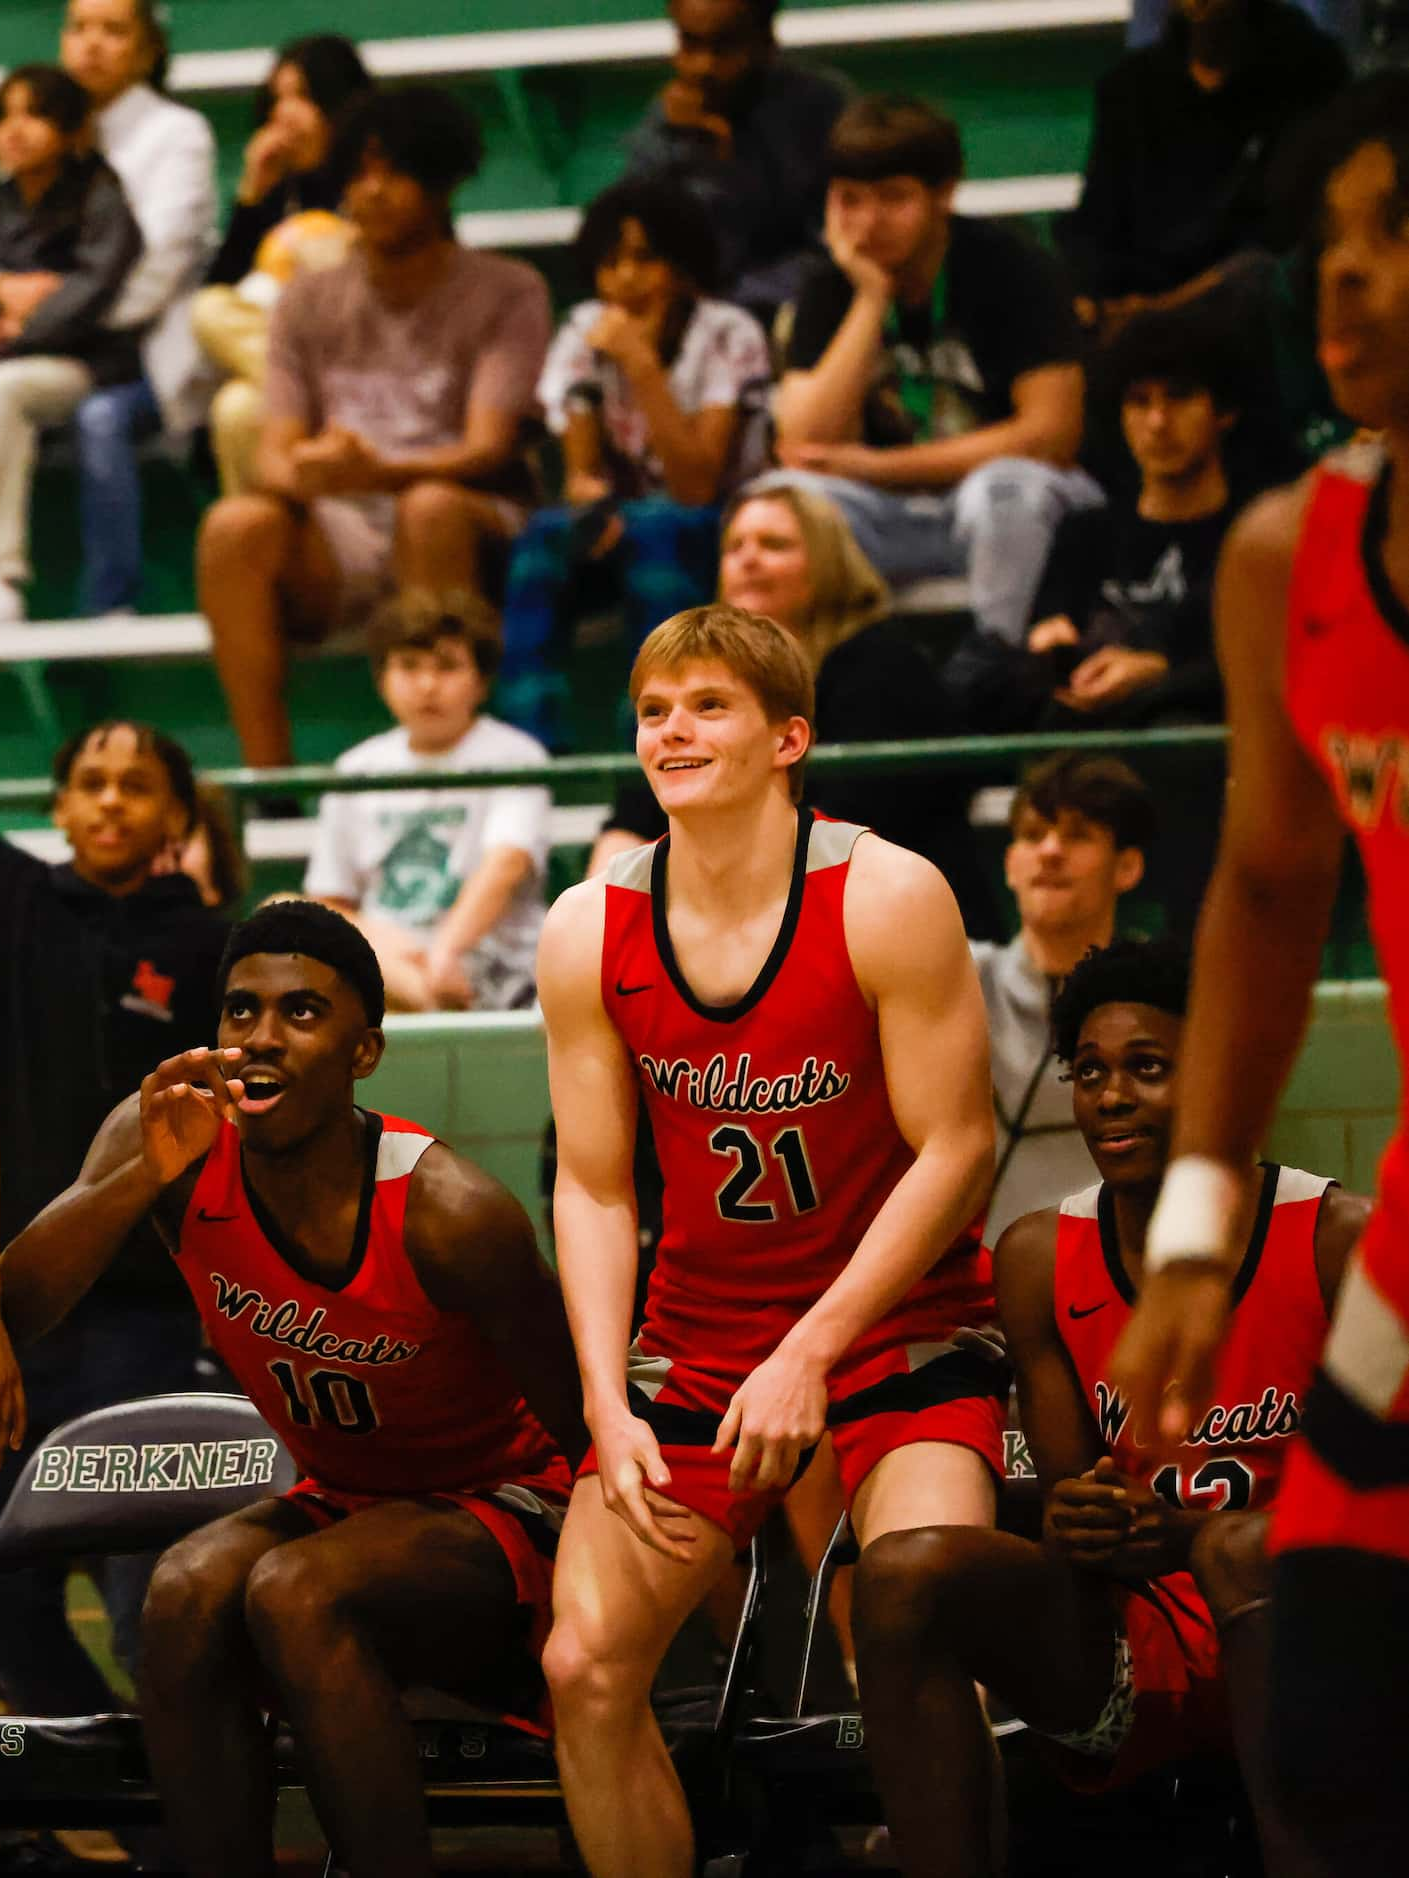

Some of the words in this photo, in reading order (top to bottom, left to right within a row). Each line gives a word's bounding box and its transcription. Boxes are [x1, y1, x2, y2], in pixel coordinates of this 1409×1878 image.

[640, 1052, 850, 1114] Wildcats
[708, 1123, 820, 1224] 21
[210, 1272, 420, 1366] Wildcats
[267, 1359, 383, 1435] 10
[1094, 1380, 1305, 1447] Wcats
[30, 1437, 279, 1493] BERKNER
